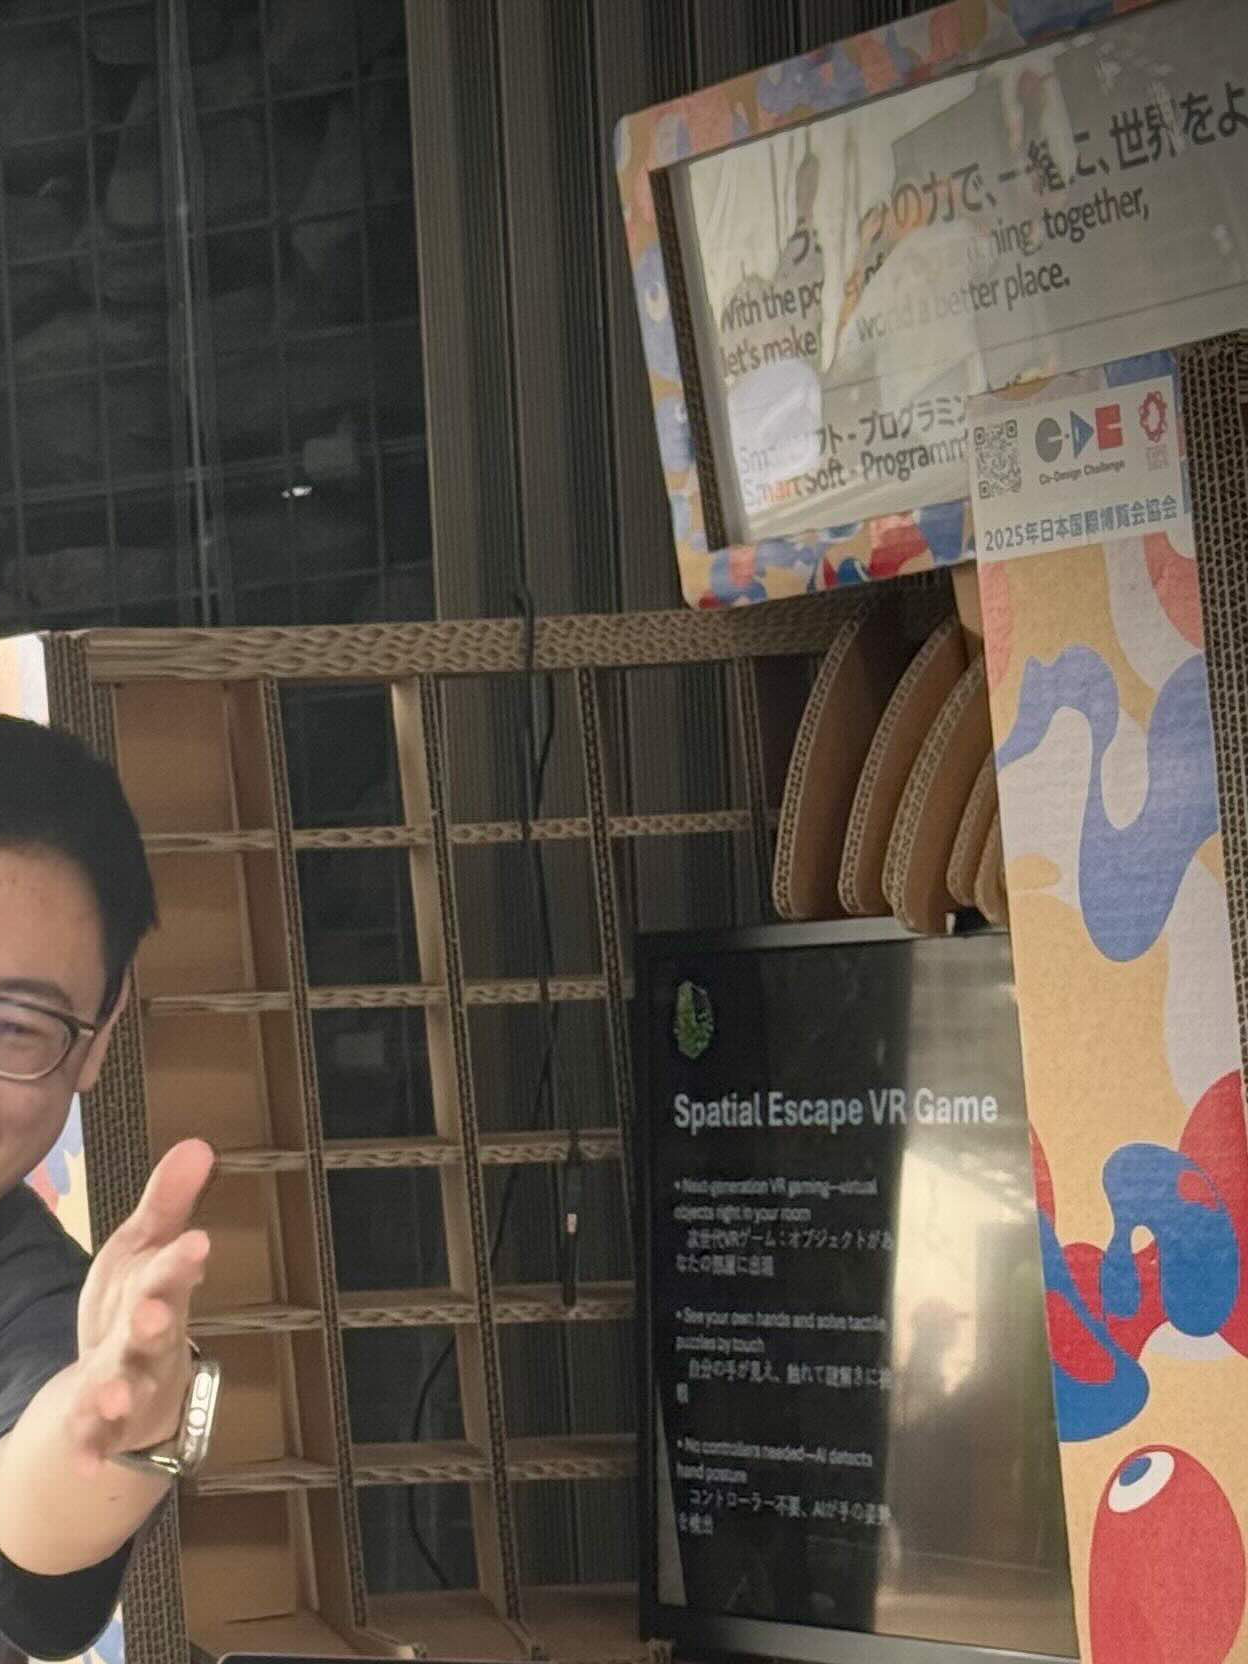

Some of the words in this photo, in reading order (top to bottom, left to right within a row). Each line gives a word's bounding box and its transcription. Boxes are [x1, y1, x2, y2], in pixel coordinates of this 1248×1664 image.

[763, 284, 796, 319] the
[1042, 186, 1149, 243] together,
[719, 337, 761, 378] let's
[763, 323, 818, 366] make
[1004, 260, 1071, 312] place.
[983, 494, 1178, 552] 2025年日本国際博覧会協会
[674, 1092, 762, 1136] Spatial
[768, 1091, 863, 1134] Escape
[867, 1087, 909, 1125] VR
[913, 1086, 999, 1124] Game
